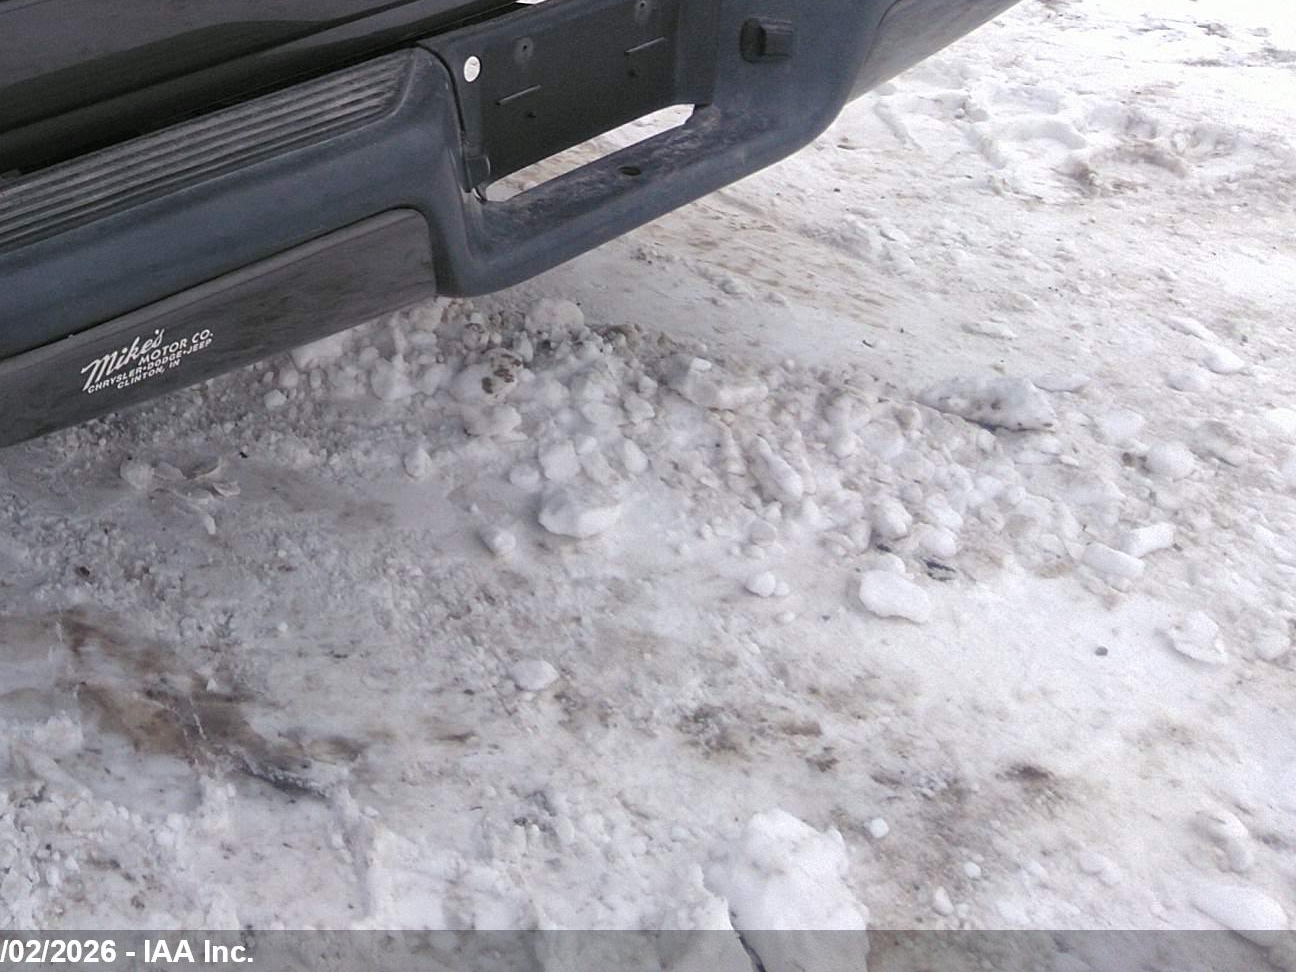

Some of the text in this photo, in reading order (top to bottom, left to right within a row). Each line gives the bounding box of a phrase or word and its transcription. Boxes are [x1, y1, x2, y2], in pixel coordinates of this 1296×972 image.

[80, 328, 165, 391] Mike's
[138, 329, 214, 366] MOTOR CO.
[117, 359, 181, 389] CLINTON, IN
